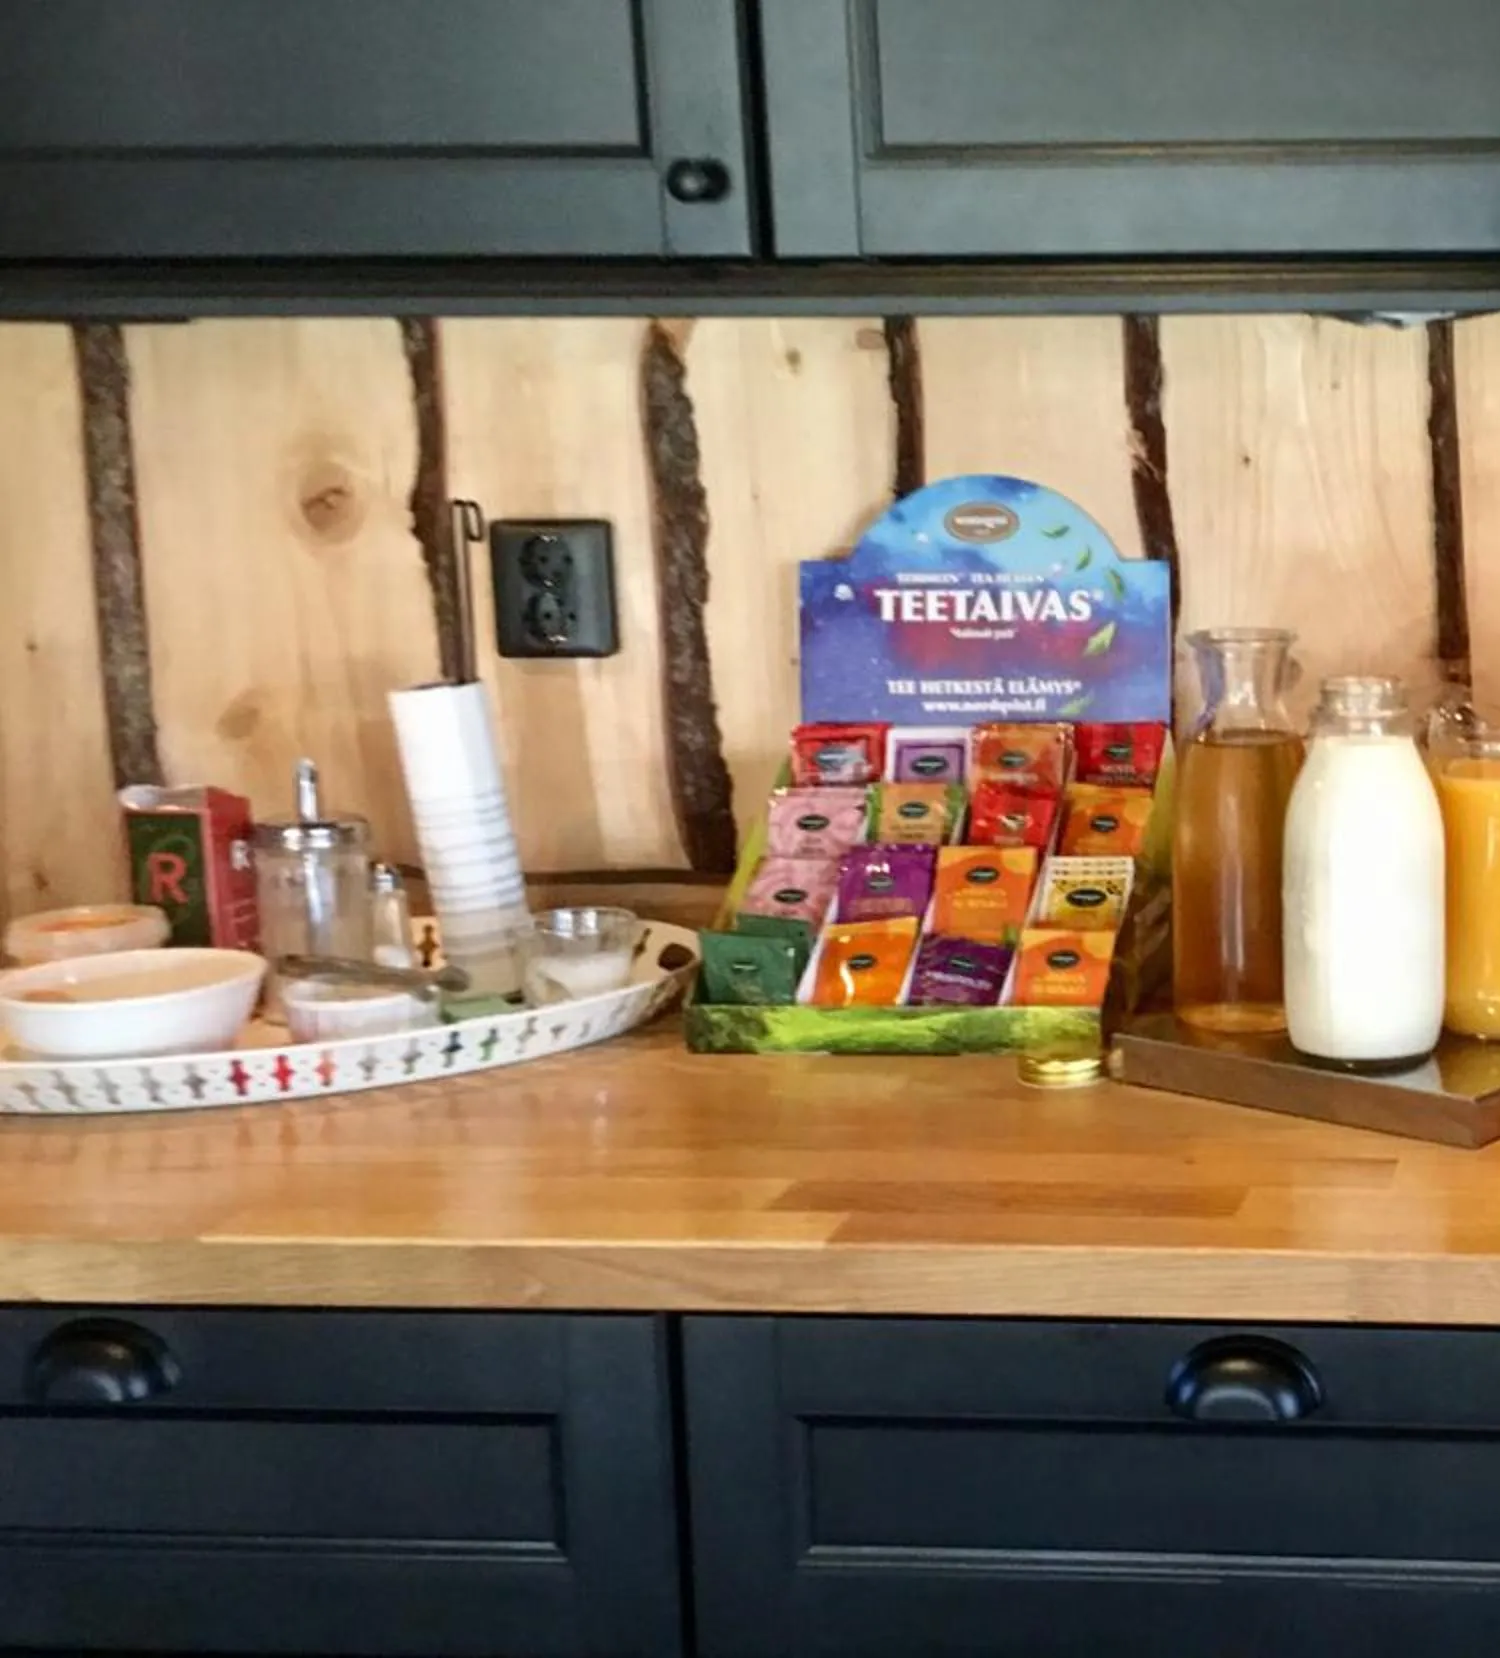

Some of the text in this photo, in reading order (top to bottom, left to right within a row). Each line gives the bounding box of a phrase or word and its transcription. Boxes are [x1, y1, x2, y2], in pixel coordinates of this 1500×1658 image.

[873, 589, 1093, 622] TEETAIVAS
[887, 679, 916, 694] TEE
[147, 852, 188, 903] R
